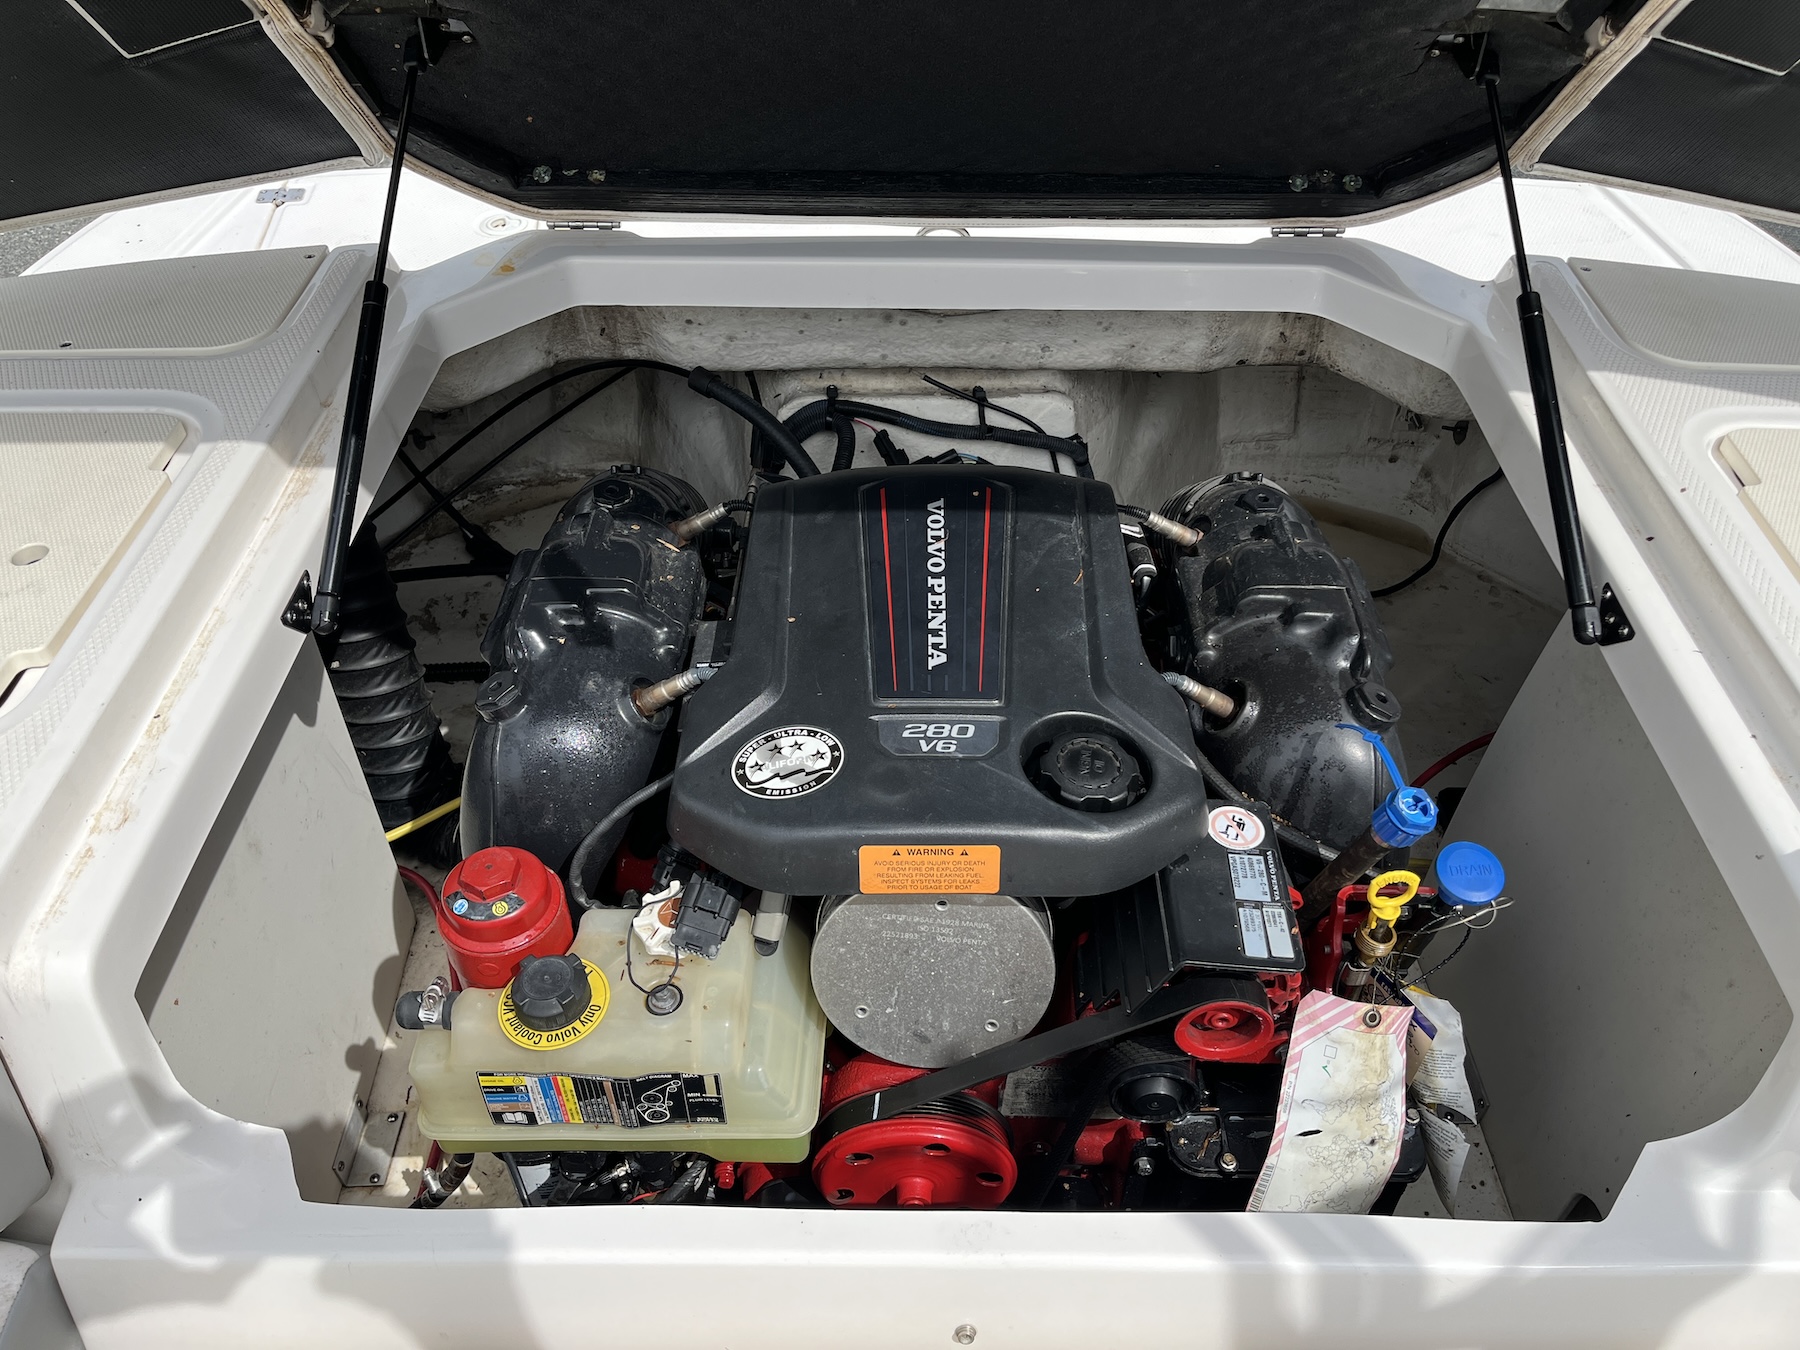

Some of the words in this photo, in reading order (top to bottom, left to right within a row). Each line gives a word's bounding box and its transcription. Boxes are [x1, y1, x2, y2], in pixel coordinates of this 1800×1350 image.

[926, 498, 946, 573] VOLVO
[928, 576, 948, 670] PENTA
[902, 723, 976, 738] 280
[739, 738, 767, 763] SUPER
[773, 730, 808, 739] ULTRA
[816, 732, 836, 746] LOW
[918, 739, 958, 753] V6
[765, 780, 817, 796] EMISSION
[1266, 851, 1276, 875] VOLVO
[1271, 875, 1280, 900] PENTA
[1448, 864, 1492, 876] DRAIN
[963, 937, 987, 945] PENTA
[579, 1004, 602, 1027] Only
[505, 1016, 543, 1044] Coolant
[546, 1026, 582, 1043] Volvo
